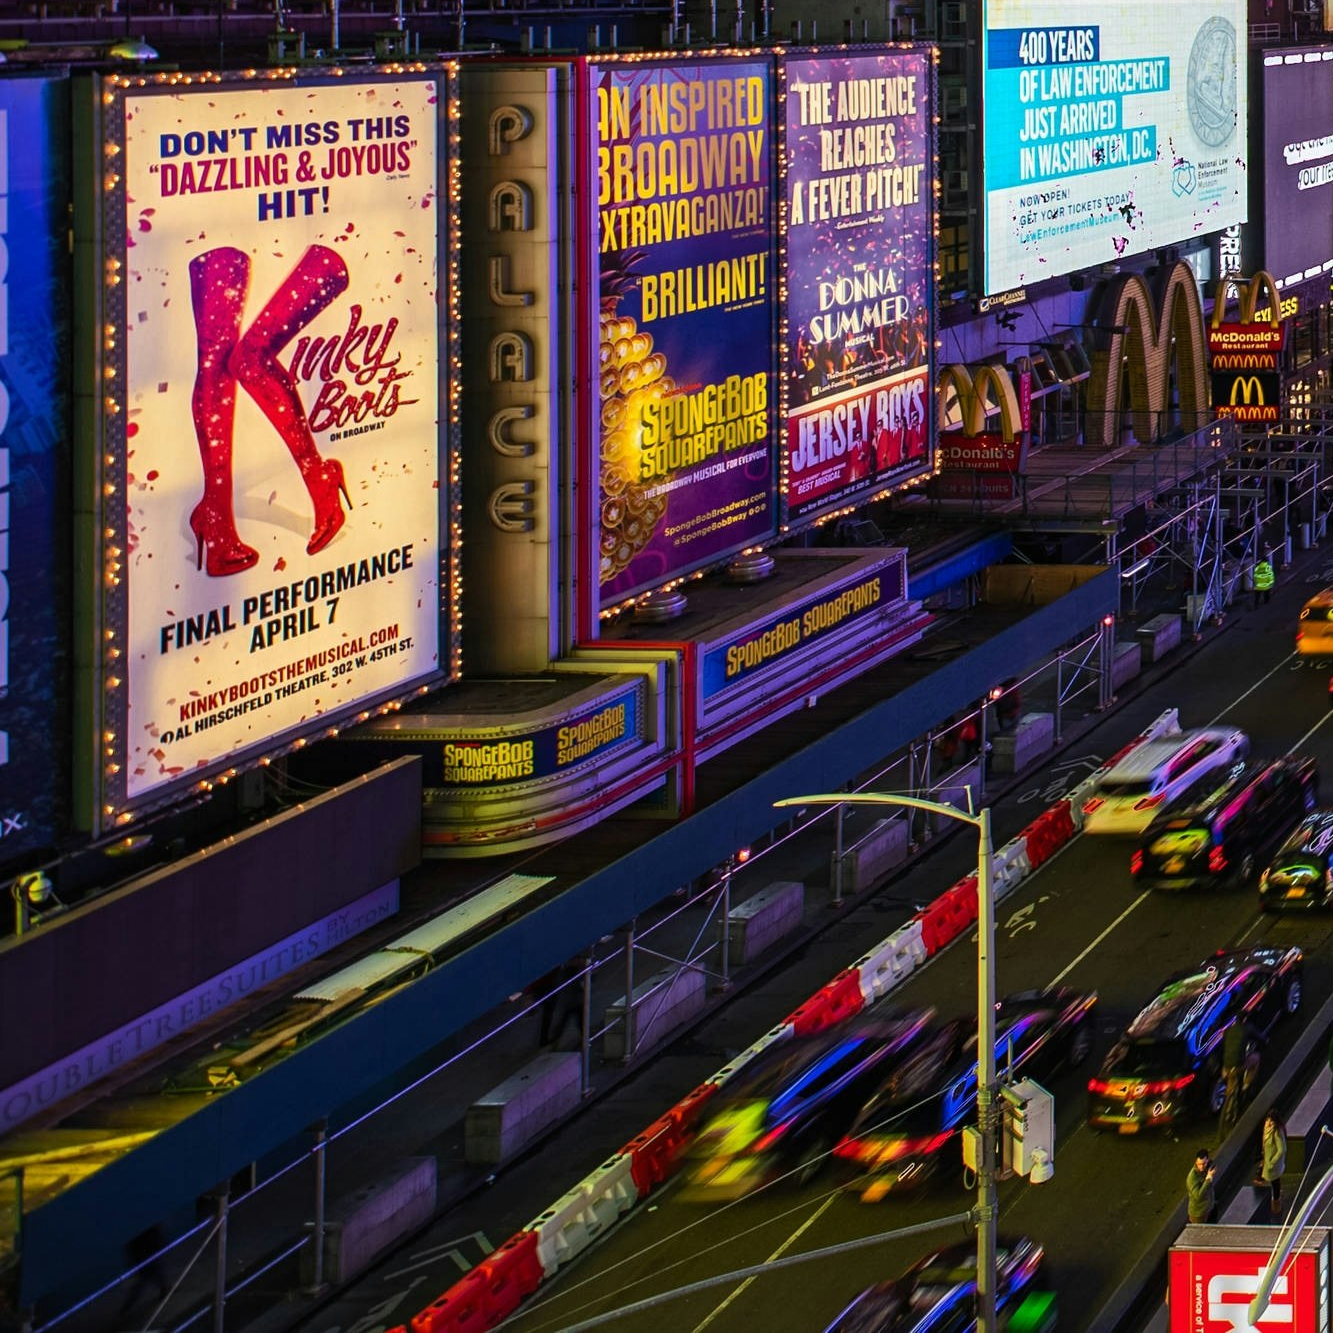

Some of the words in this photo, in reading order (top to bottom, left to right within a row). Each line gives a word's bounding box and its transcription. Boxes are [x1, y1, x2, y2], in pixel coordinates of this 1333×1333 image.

[1019, 31, 1046, 64] 400
[1049, 28, 1094, 63] YEARS
[837, 75, 916, 122] AUDIENCE
[1019, 68, 1038, 103] OF
[1040, 67, 1072, 101] LAW
[1075, 59, 1165, 98] ENFORCEMENT
[640, 76, 763, 138] INSPIRED
[1020, 106, 1057, 141] JUST
[1060, 99, 1116, 138] ARRIVED
[160, 127, 257, 158] DON'T
[266, 120, 340, 149] MISS
[347, 114, 410, 142] THIS
[820, 122, 896, 173] REACHES
[1020, 147, 1037, 180] IN
[1132, 129, 1151, 164] DC.
[295, 150, 316, 183] &
[598, 129, 764, 206] BROADWAY
[258, 185, 330, 222] HIT!
[790, 181, 804, 226] A
[808, 173, 862, 223] FEVER
[1068, 199, 1102, 216] TICKETS
[819, 267, 897, 312] DONNA
[809, 294, 910, 346] SUMMER
[844, 333, 875, 350] MUSICAL
[1210, 330, 1281, 343] McDonald's
[791, 392, 872, 474] JERSEY
[657, 476, 693, 495] BROADWAY
[797, 479, 815, 495] BEST
[816, 470, 841, 490] MUSICAL
[160, 605, 236, 655] FINAL
[243, 544, 414, 626] PERFORMANCE
[250, 605, 320, 654] APRIL
[326, 597, 340, 624] 7
[727, 617, 800, 678] SPONGEBOB
[179, 623, 399, 722] KINKYBOOTSTHEMUSICAL.COM
